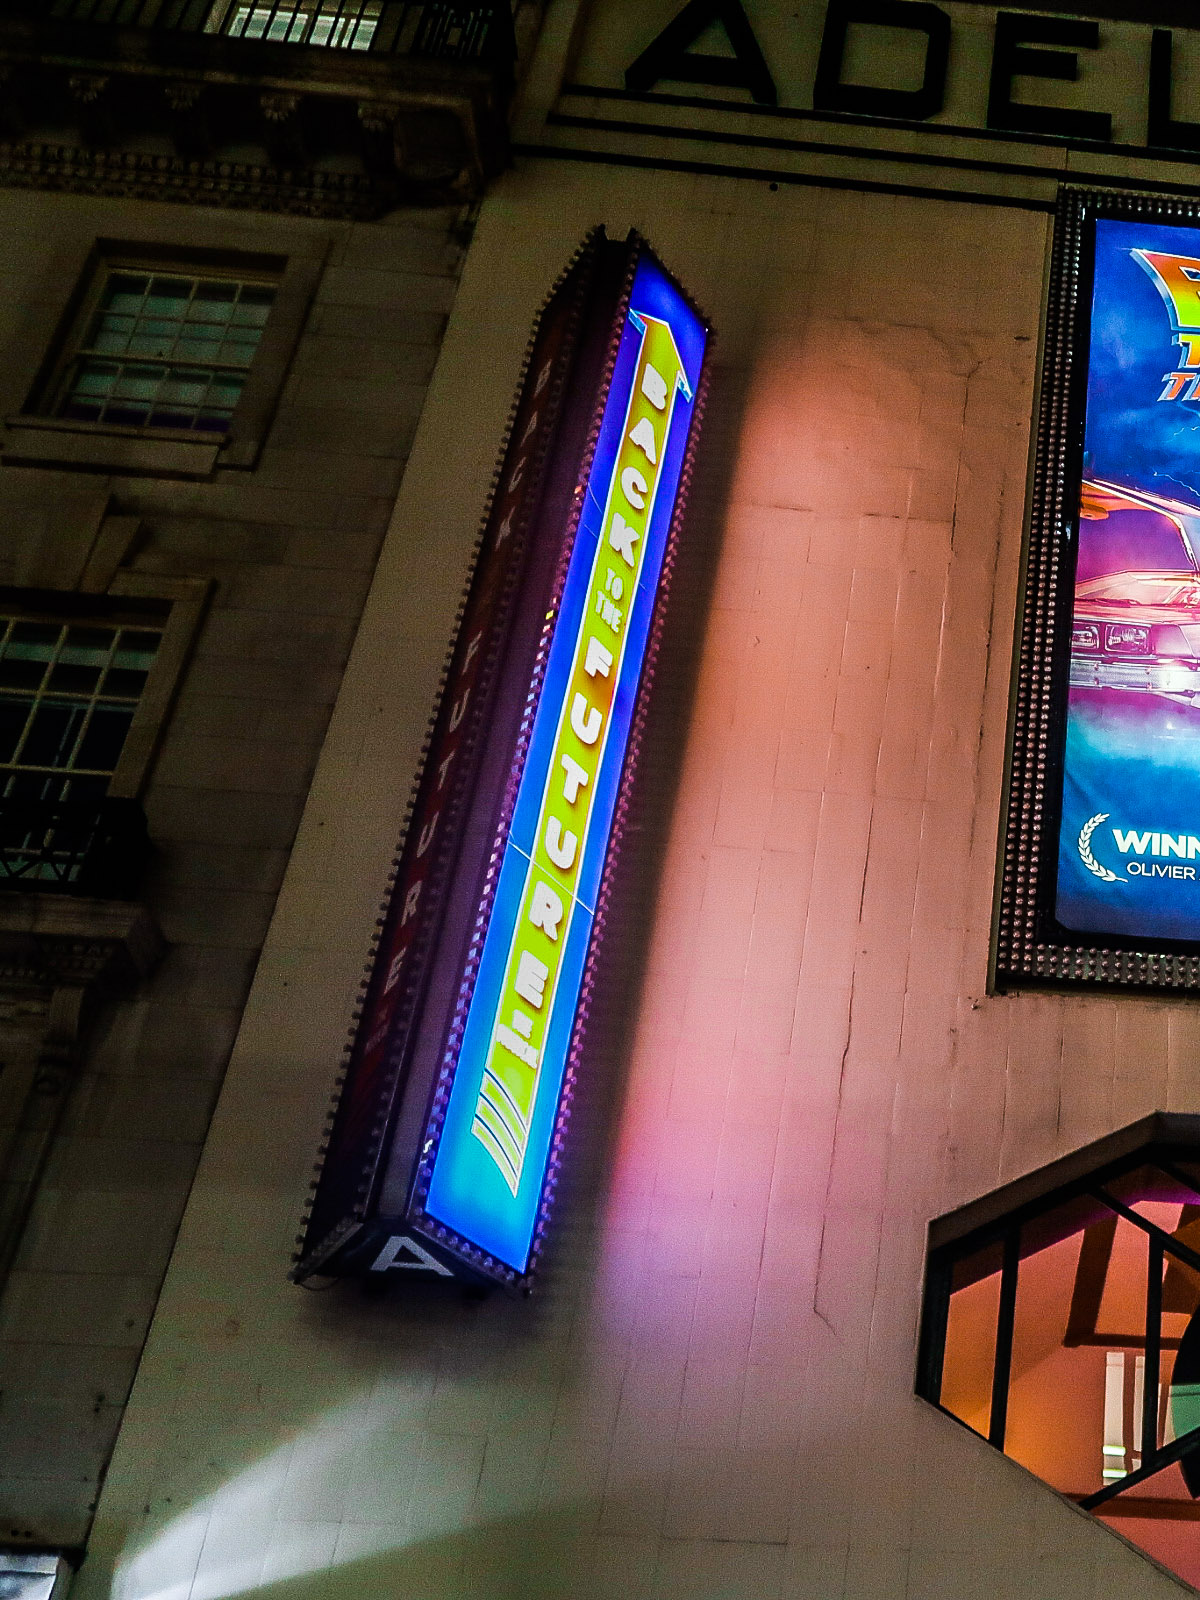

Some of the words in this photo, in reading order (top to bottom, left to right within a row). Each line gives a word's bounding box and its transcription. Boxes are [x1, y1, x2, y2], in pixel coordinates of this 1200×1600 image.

[609, 362, 669, 568] BACK
[604, 567, 624, 601] TO
[595, 590, 623, 633] THE
[514, 635, 613, 1009] FUTURE
[1126, 862, 1195, 880] OLIVIER
[371, 1236, 455, 1277] A
